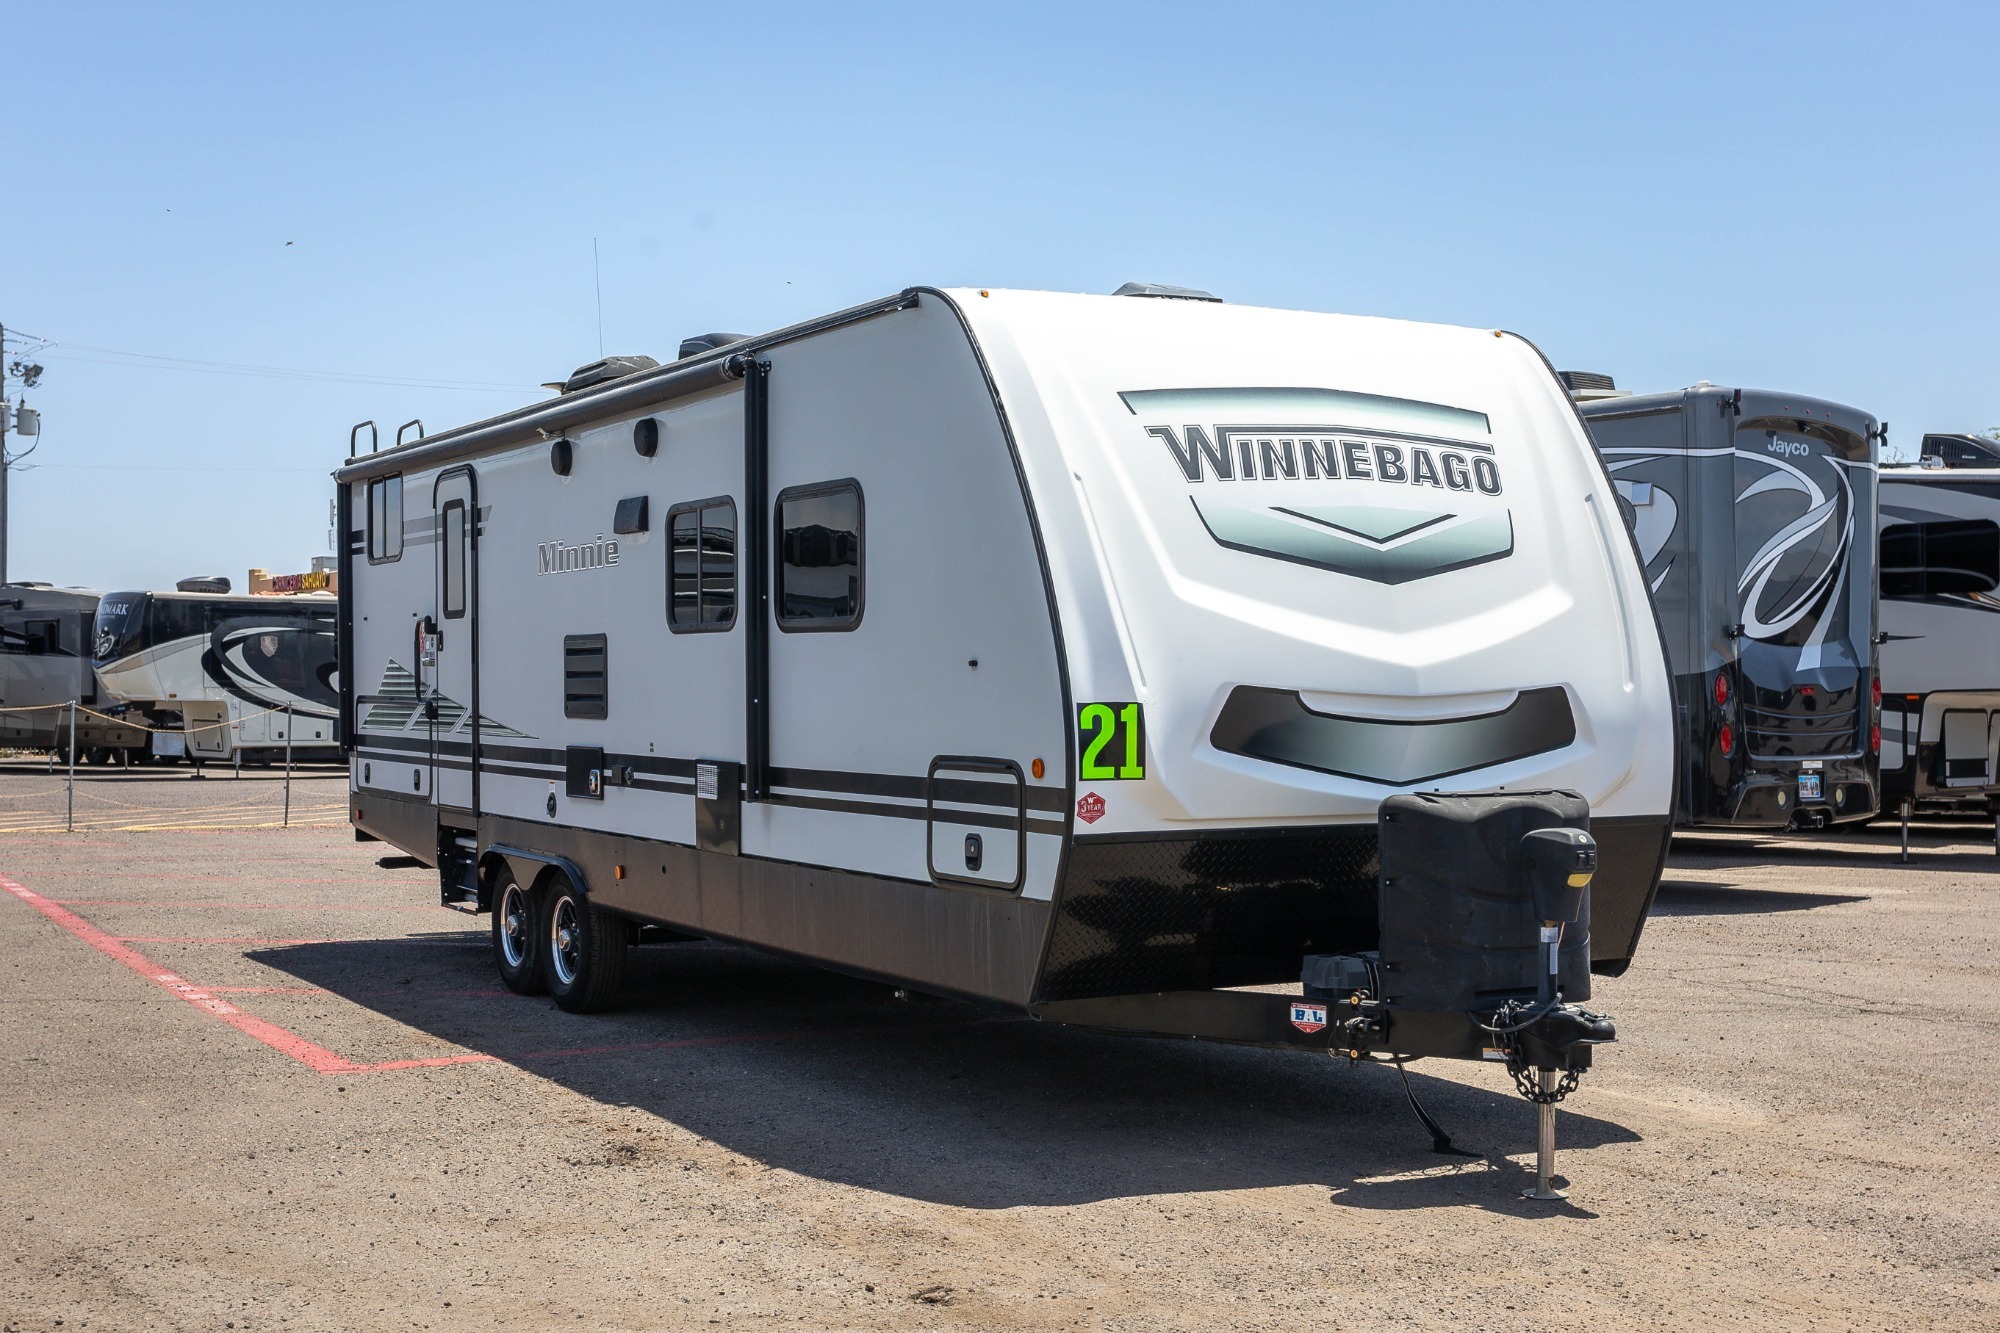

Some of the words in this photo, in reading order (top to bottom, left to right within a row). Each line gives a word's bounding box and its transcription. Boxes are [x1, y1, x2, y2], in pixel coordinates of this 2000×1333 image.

[1144, 424, 1502, 496] WINNEBAGO
[1767, 435, 1810, 458] Jayco
[537, 532, 620, 577] Minnie
[1080, 703, 1143, 779] 21
[1080, 801, 1087, 813] 3
[1087, 803, 1102, 811] YEAR
[1294, 1009, 1323, 1023] BAL
